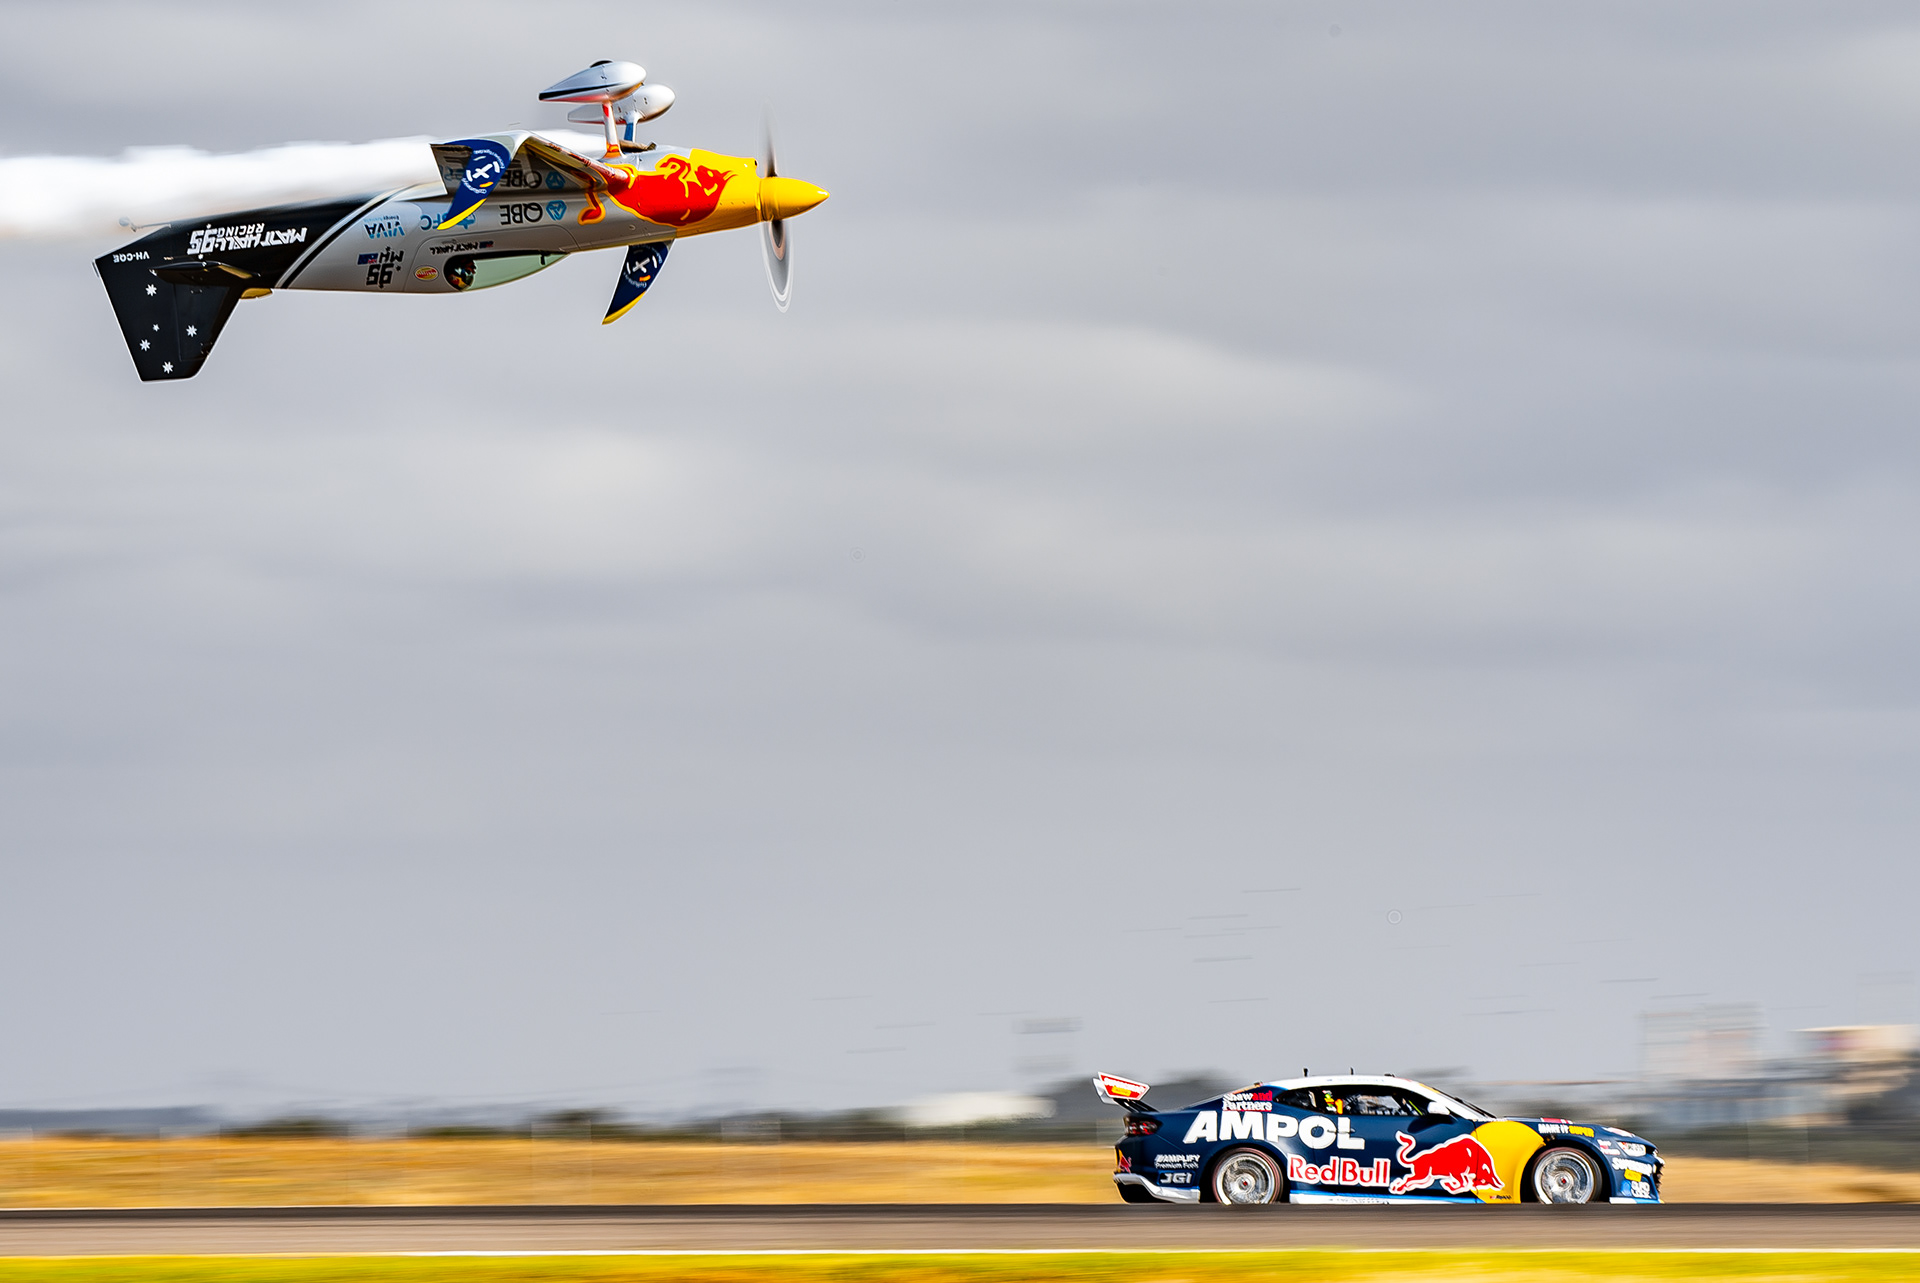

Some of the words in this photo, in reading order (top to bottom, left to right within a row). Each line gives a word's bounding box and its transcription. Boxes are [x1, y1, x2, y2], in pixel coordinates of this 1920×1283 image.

[500, 202, 543, 225] QBE
[216, 223, 264, 238] RACING
[364, 221, 406, 240] VIVA
[365, 263, 394, 286] 95
[1222, 1101, 1273, 1111] Partners
[1183, 1110, 1365, 1150] AMPOL
[1157, 1154, 1200, 1163] AMPLIFY
[1160, 1172, 1193, 1184] JGI
